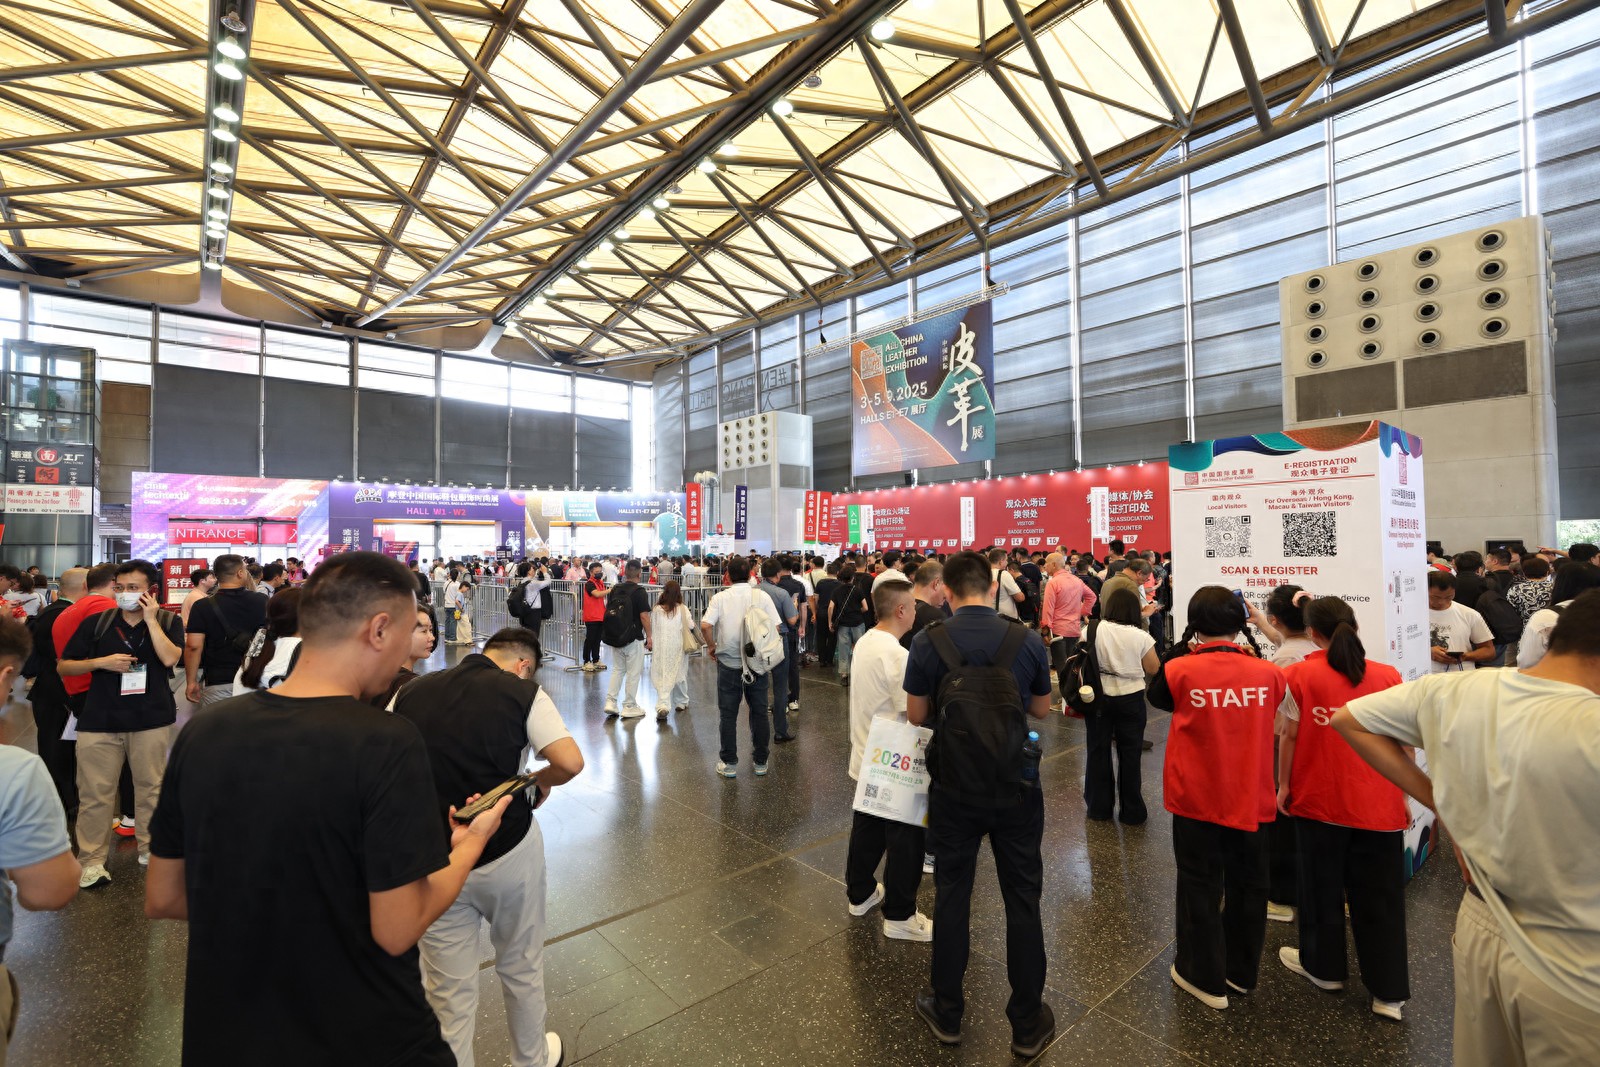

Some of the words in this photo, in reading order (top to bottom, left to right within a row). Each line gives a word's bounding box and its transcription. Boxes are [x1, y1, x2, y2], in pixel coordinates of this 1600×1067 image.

[885, 342, 899, 351] ALL
[900, 333, 924, 346] CHINA
[886, 347, 918, 362] LEATHER
[886, 356, 928, 373] EXHIBITION
[861, 412, 884, 424] HALLS
[886, 407, 909, 419] E1-E7
[41, 450, 55, 461] 面
[1284, 457, 1357, 469] E-REGISTRATION
[1202, 468, 1254, 478] 中国国际皮革展
[1291, 466, 1349, 477] 观众电子登记
[1291, 488, 1325, 496] 海外观众
[1005, 497, 1047, 508] 观众入场证
[850, 511, 857, 525] 入口
[1014, 509, 1038, 519] 换领处
[169, 528, 246, 538] ENTRANCE
[1220, 566, 1250, 575] SCAN
[1252, 566, 1260, 575] &
[1263, 566, 1318, 575] REGISTER
[167, 578, 195, 587] 寄存
[1246, 578, 1289, 587] 扫码登记
[1243, 591, 1254, 599] QR
[1341, 594, 1371, 602] device
[1190, 687, 1268, 707] STAFF
[871, 748, 911, 771] 2026
